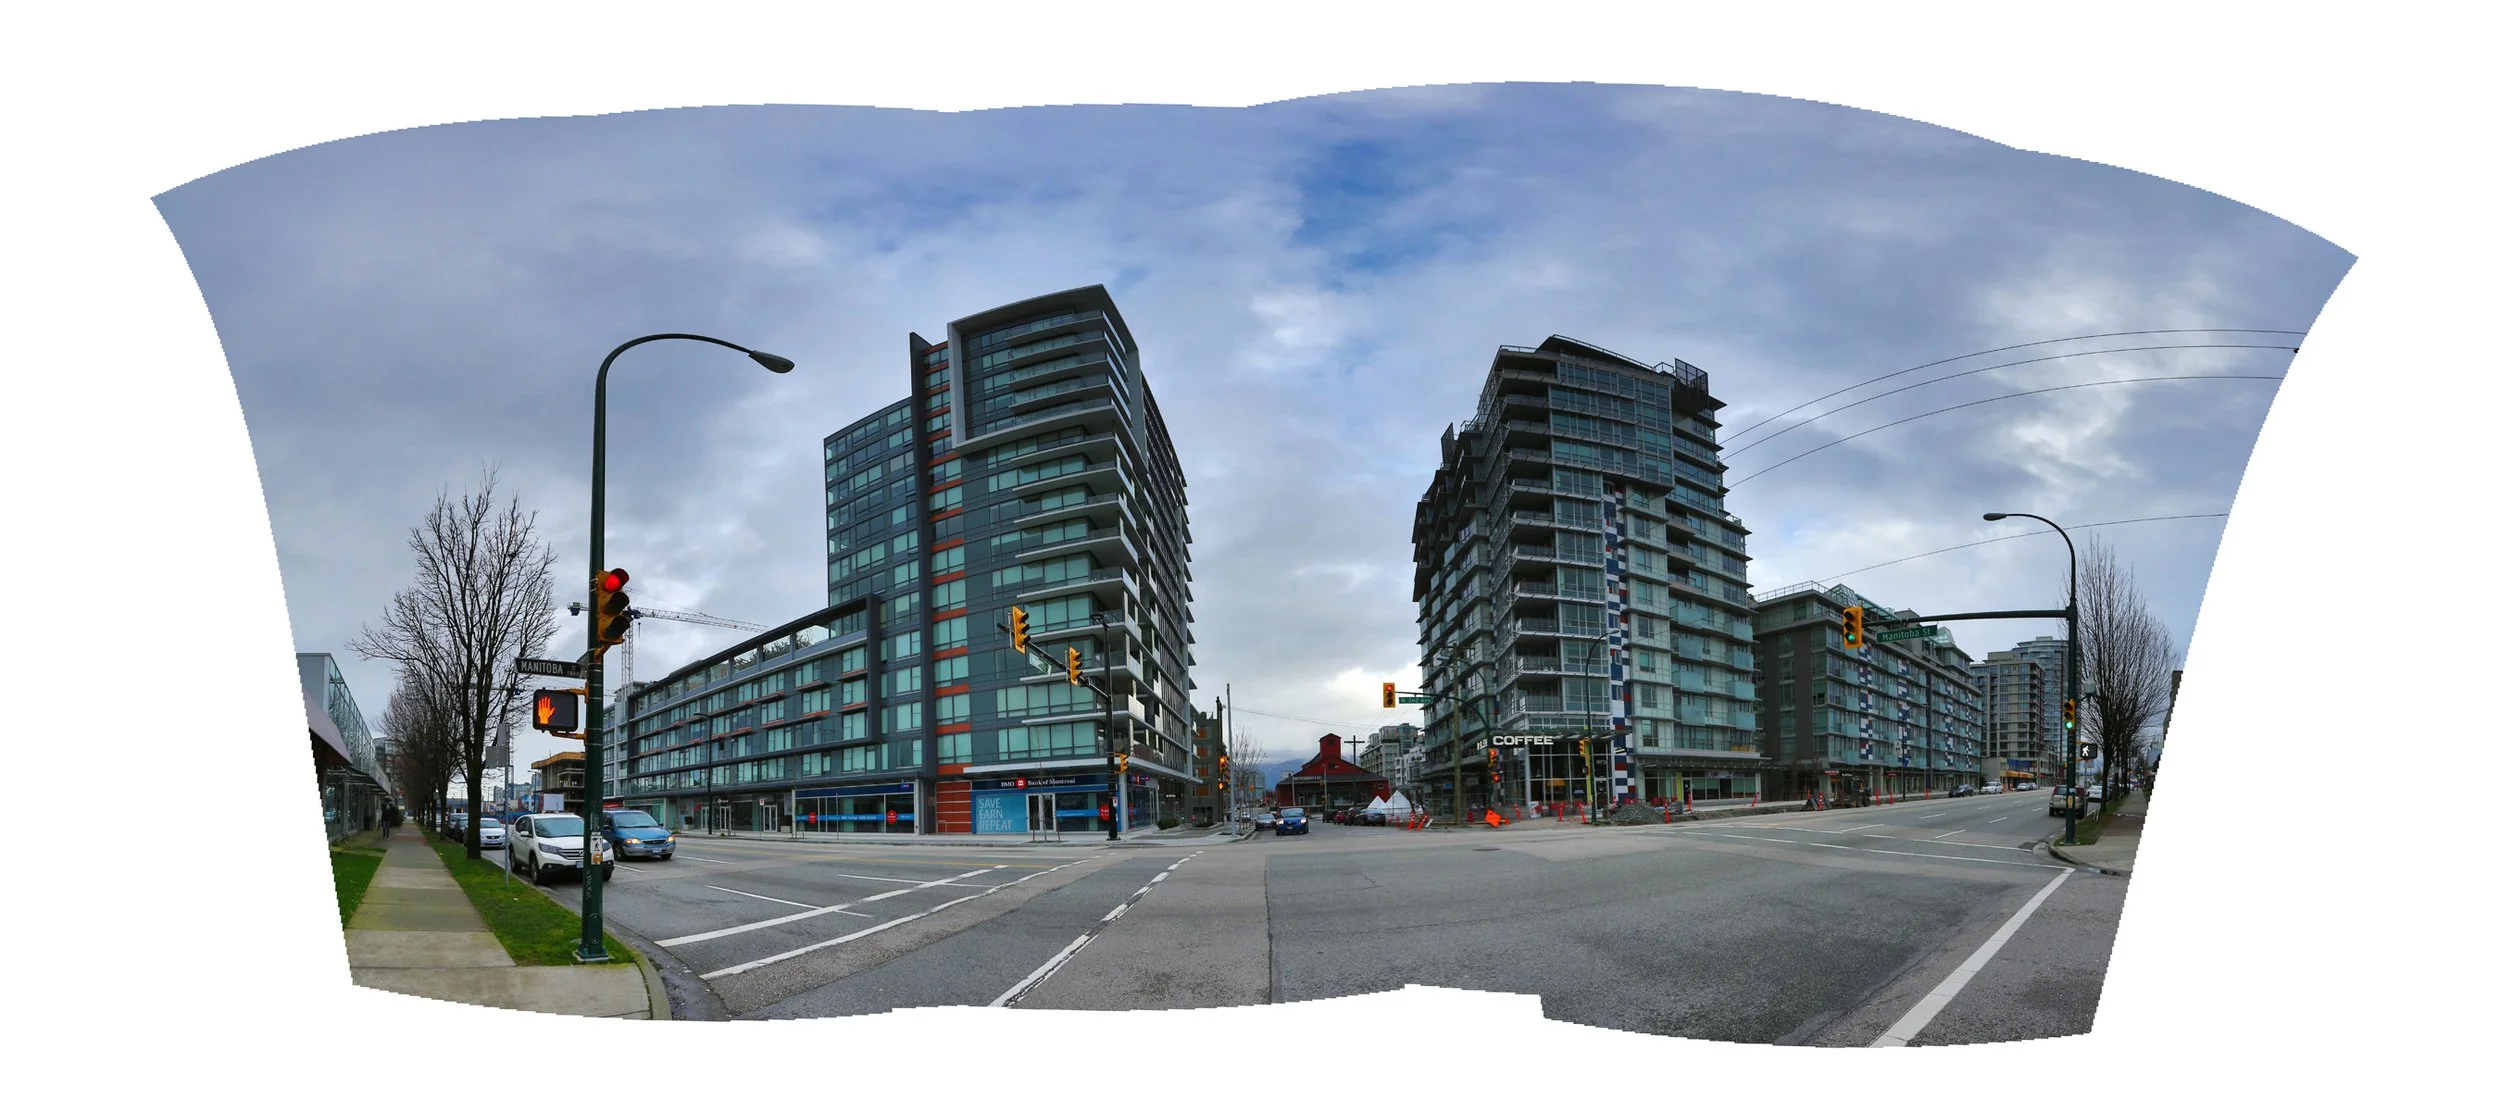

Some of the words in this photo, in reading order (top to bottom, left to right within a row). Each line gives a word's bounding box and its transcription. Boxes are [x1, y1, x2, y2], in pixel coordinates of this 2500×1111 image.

[1882, 631, 1919, 641] Manitoba
[1922, 627, 1930, 636] St
[521, 660, 563, 675] MANITOBA
[1492, 735, 1554, 746] COFFEE
[1049, 777, 1076, 786] Montreal
[979, 798, 1001, 809] SAVE
[979, 809, 1003, 820] EARN
[979, 819, 1012, 831] REPEAT
